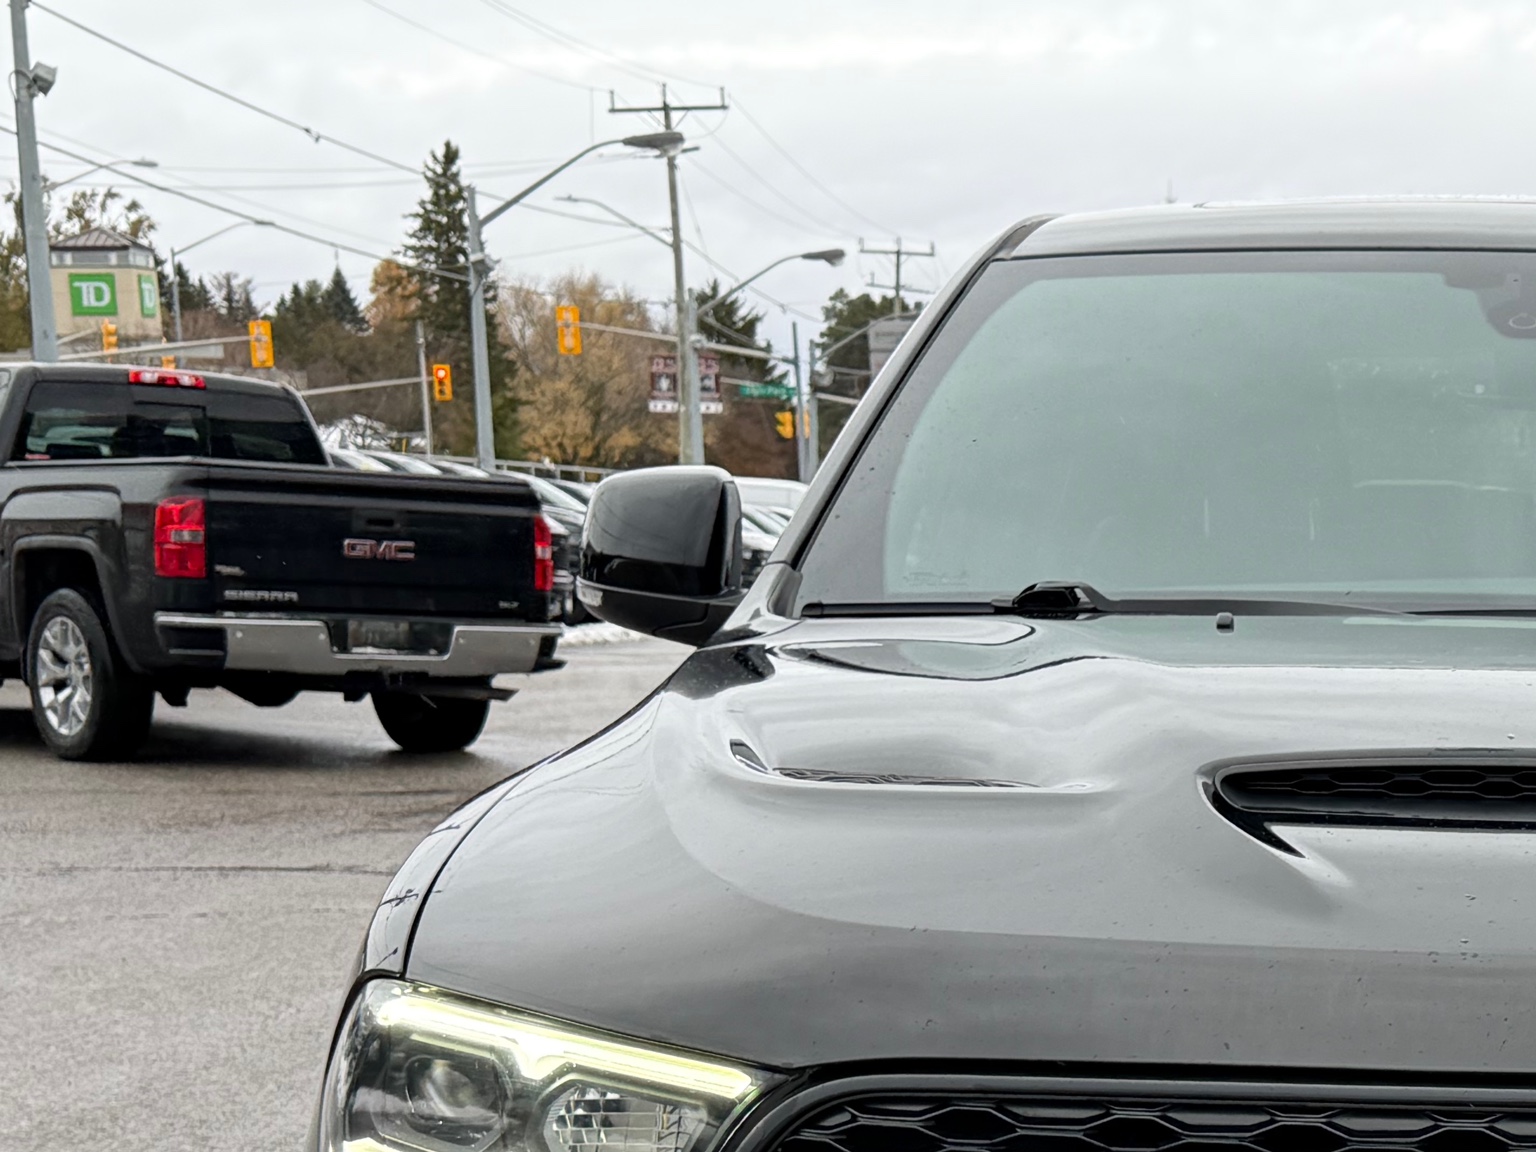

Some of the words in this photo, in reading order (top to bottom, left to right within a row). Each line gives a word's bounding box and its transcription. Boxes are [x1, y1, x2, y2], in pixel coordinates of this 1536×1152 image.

[72, 281, 111, 307] TD
[343, 538, 416, 560] GMC
[223, 589, 299, 602] SIERRA
